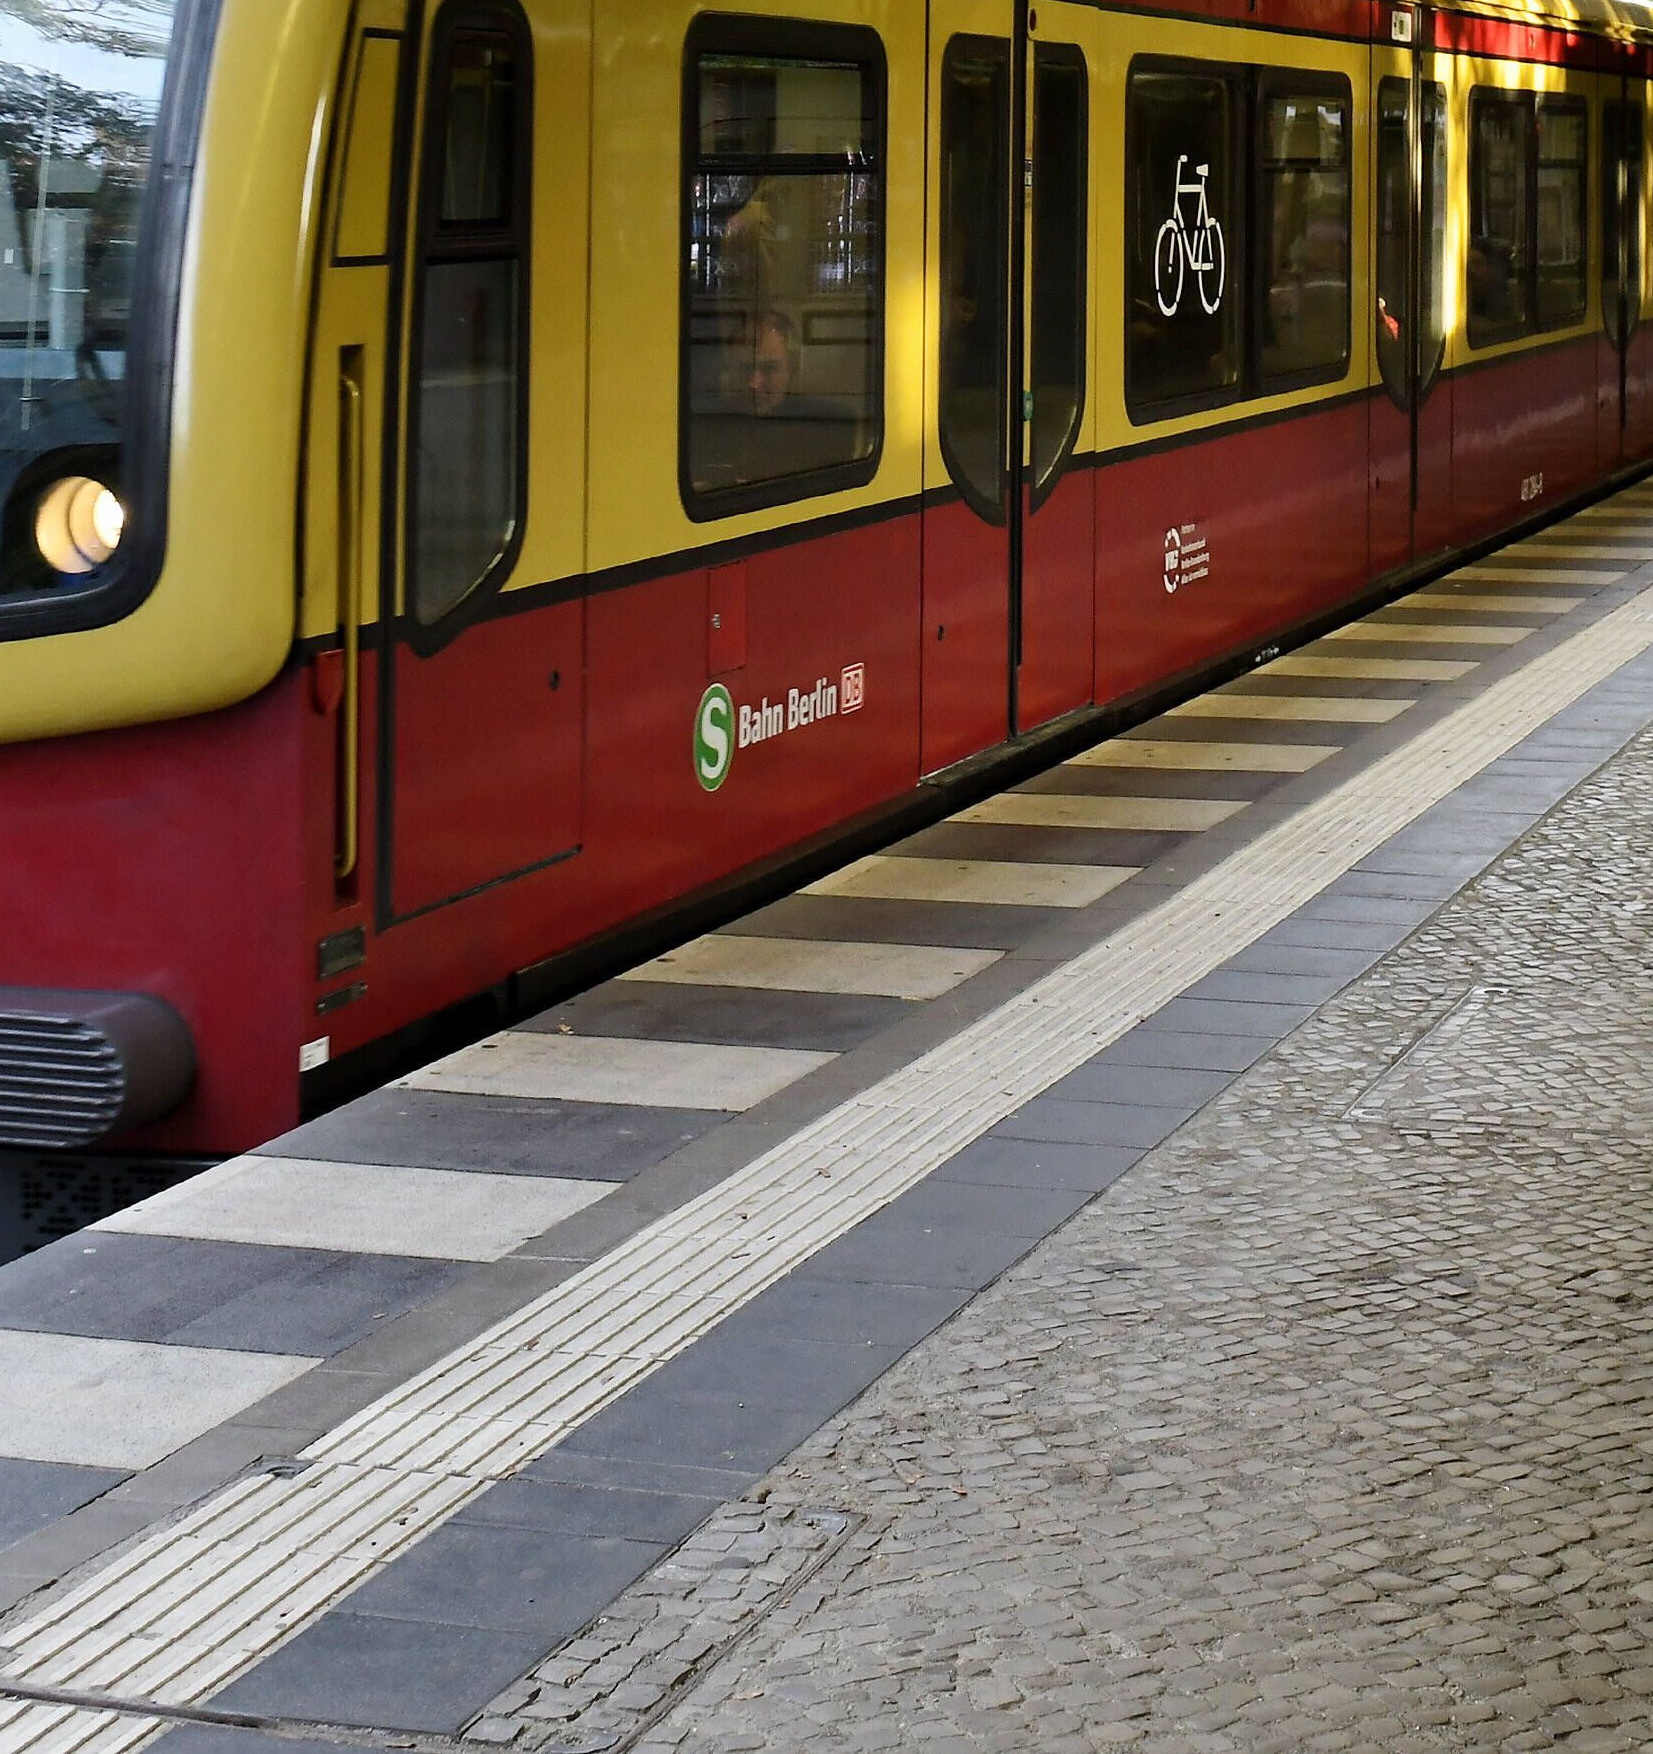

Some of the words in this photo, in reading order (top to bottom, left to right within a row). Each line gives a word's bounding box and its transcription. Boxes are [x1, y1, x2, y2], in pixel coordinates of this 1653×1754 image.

[700, 696, 730, 779] S
[738, 696, 784, 749] Bahn
[787, 676, 837, 731] Berlin
